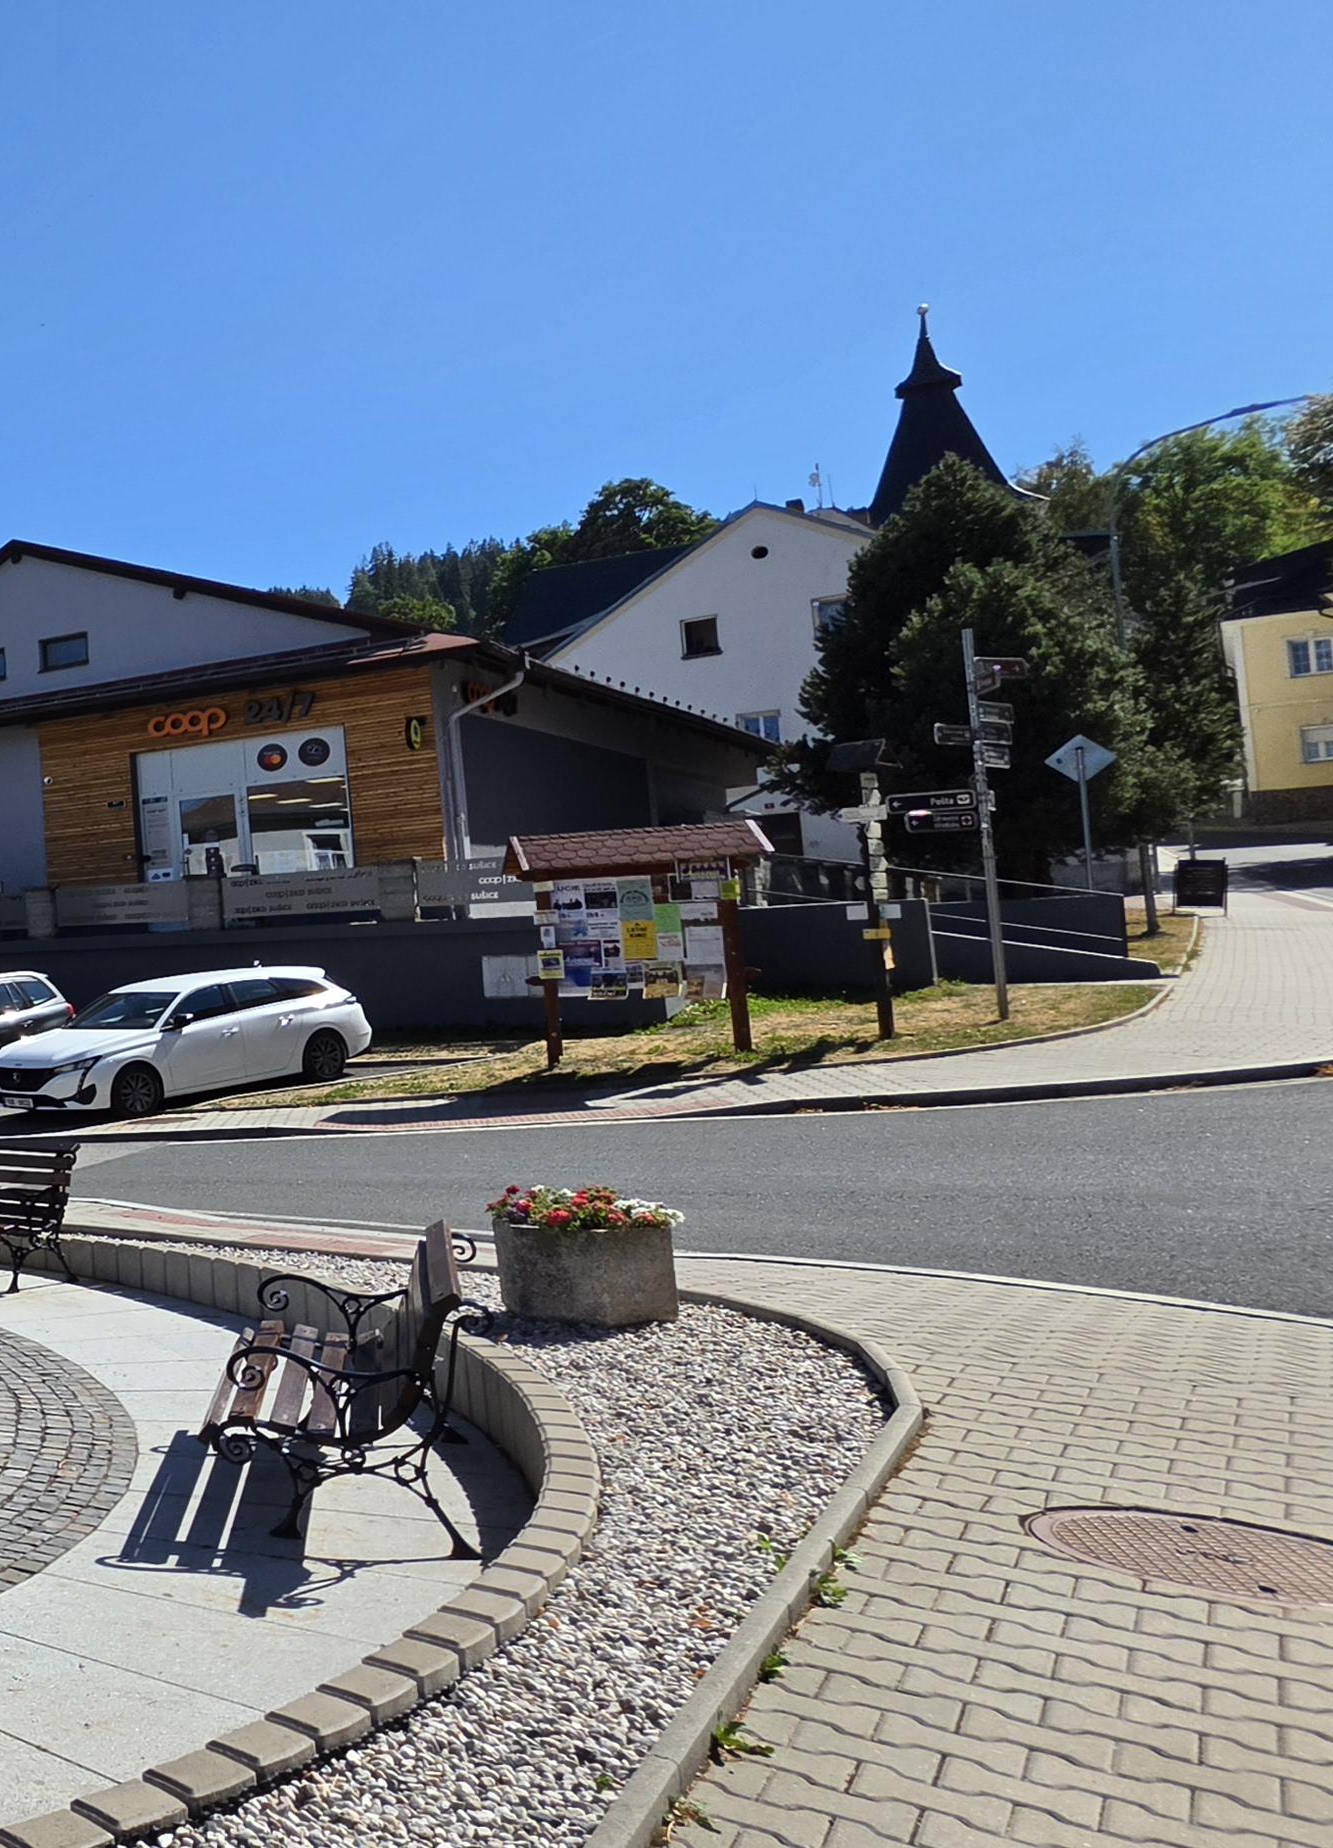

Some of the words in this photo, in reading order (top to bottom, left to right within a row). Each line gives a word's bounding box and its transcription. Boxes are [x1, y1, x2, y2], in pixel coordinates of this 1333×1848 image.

[147, 707, 228, 737] coop
[244, 690, 316, 725] 24/7
[930, 797, 954, 805] Pošta
